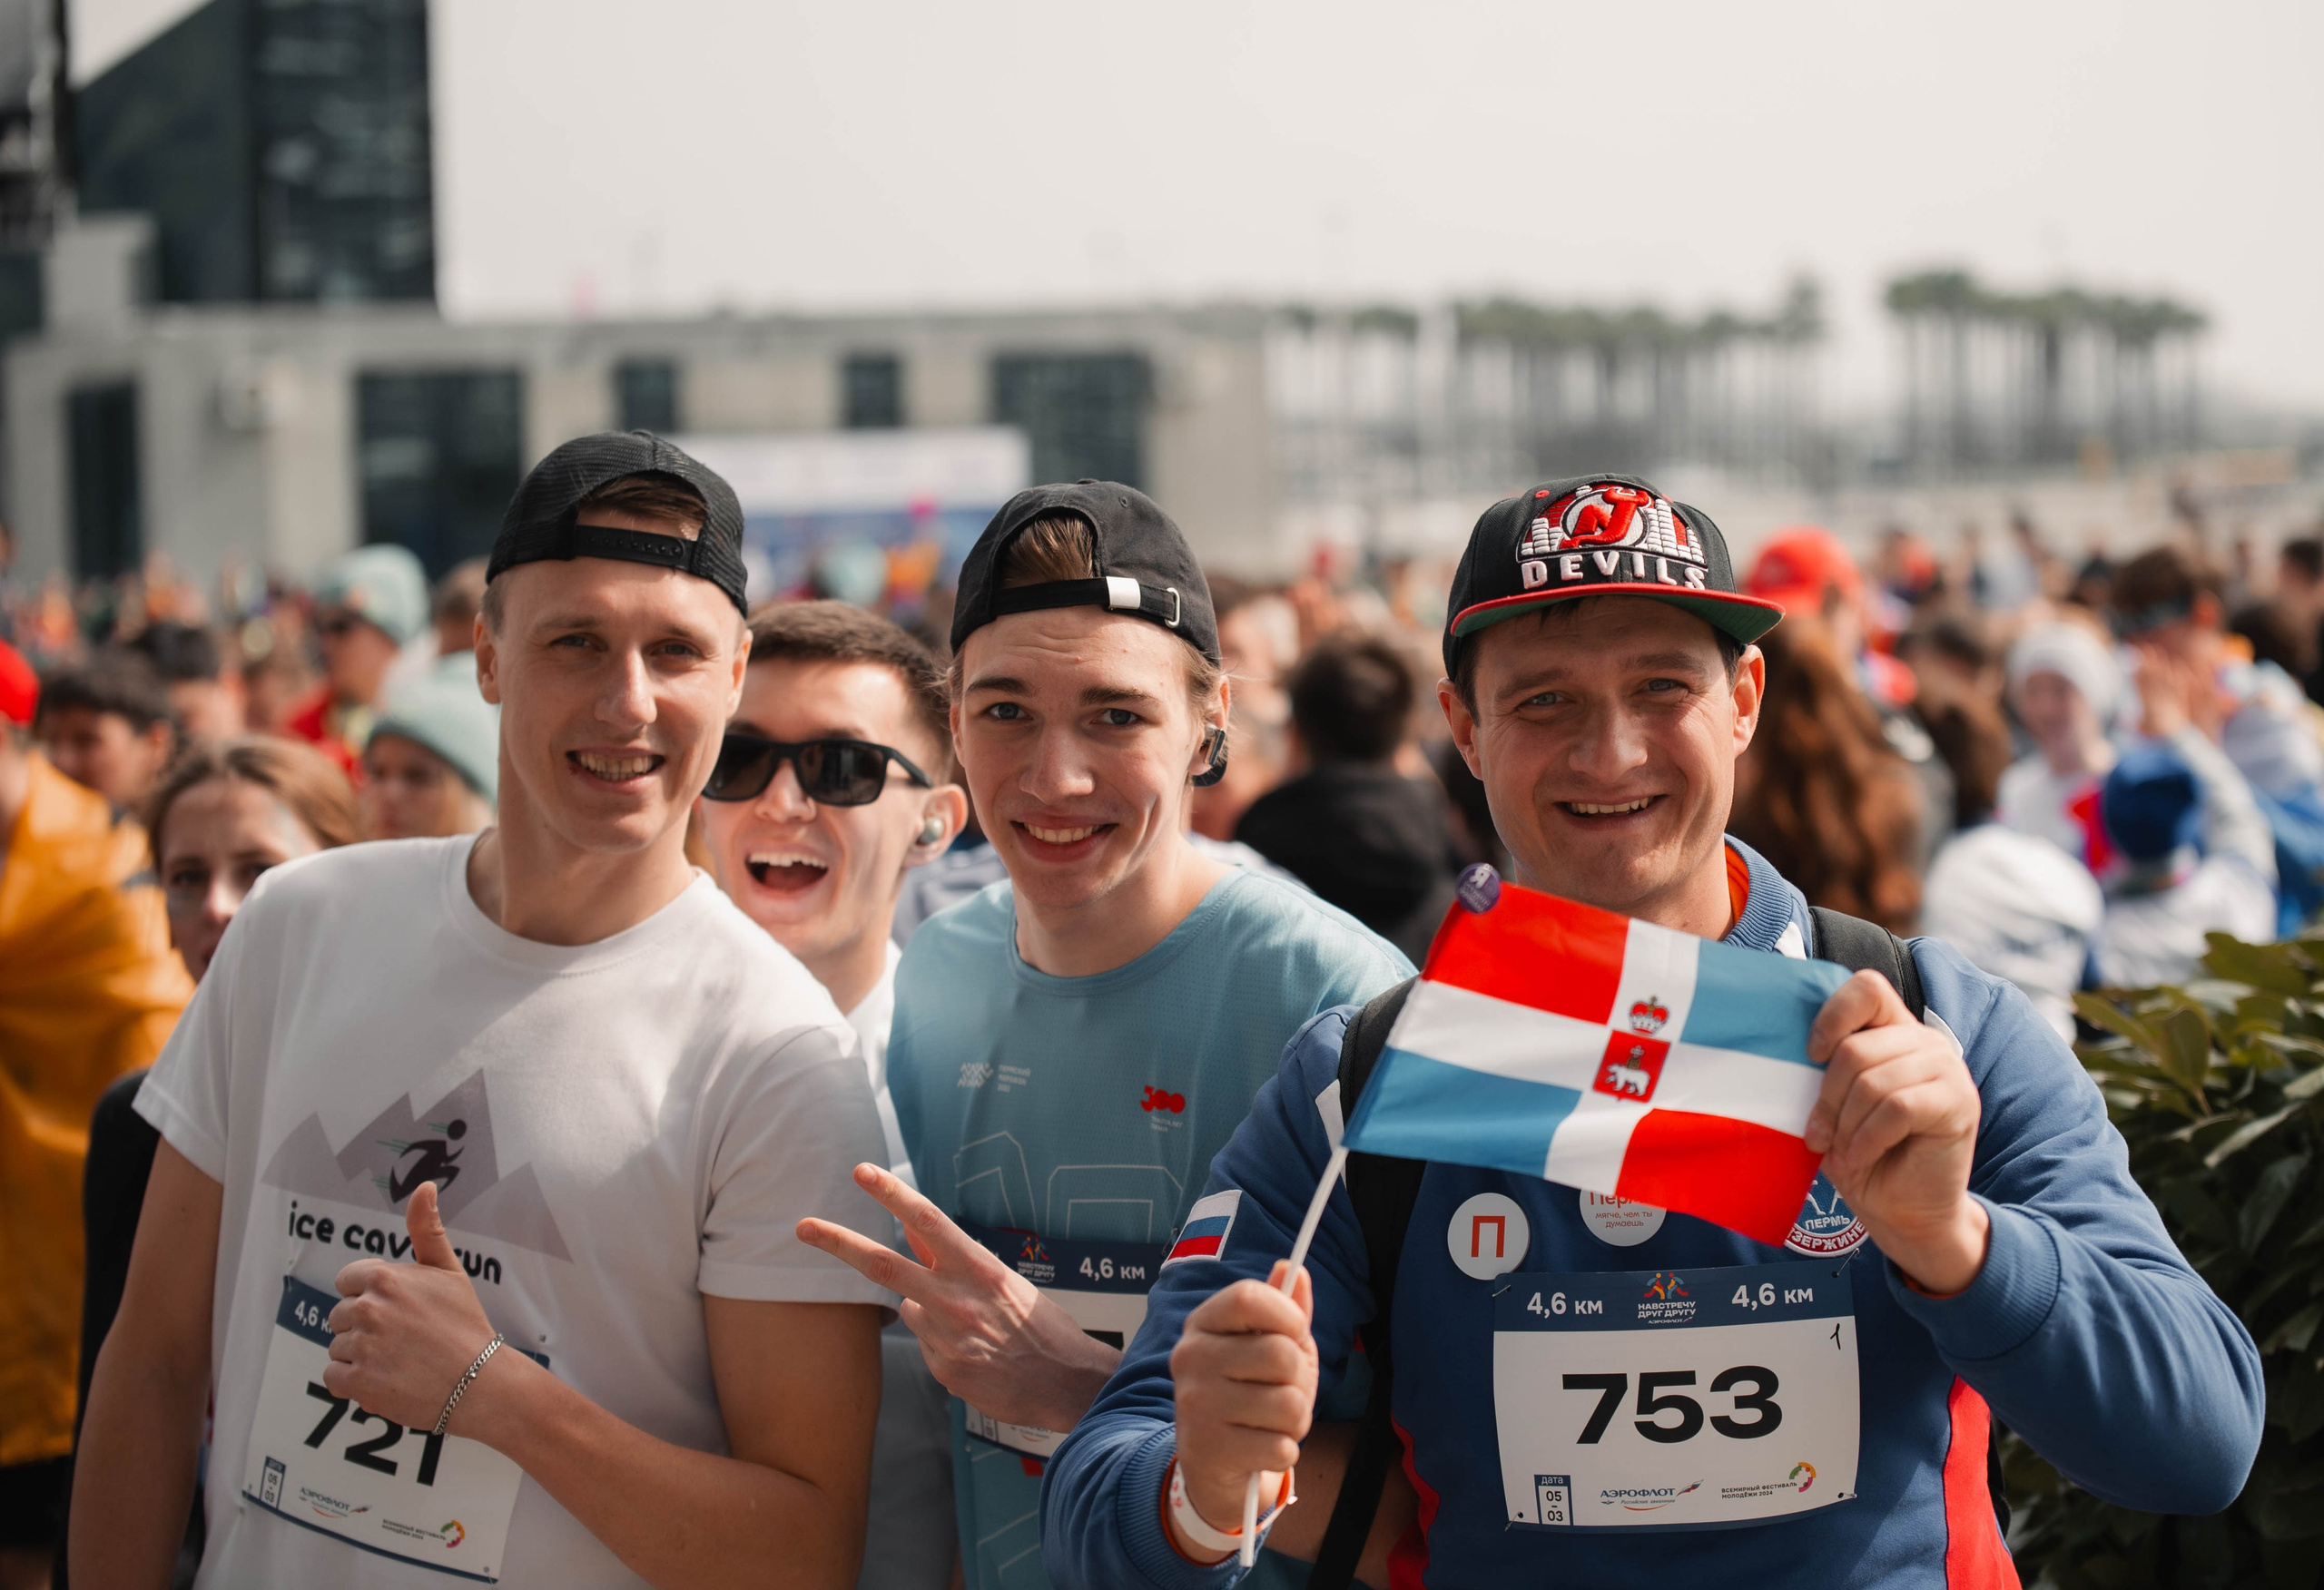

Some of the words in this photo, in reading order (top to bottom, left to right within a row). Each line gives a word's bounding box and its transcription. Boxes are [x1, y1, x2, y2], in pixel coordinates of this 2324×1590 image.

[1521, 550, 1706, 591] DEVILS
[288, 1200, 335, 1244] ice
[342, 1223, 418, 1261] cav
[1605, 1220, 1644, 1229] думаешь
[1805, 1215, 1851, 1231] ПЕРМЬ
[1471, 1215, 1506, 1259] П
[1079, 1257, 1115, 1281] 4,6
[1527, 1292, 1567, 1319] 4,6
[1575, 1300, 1603, 1315] км
[1638, 1300, 1696, 1310] НАВСТРЕЧУ
[1731, 1282, 1776, 1310] 4,6
[1784, 1287, 1814, 1304] км
[294, 1300, 319, 1328] 4,6
[320, 1317, 332, 1334] к
[1638, 1310, 1663, 1319] ДРУГ
[1664, 1309, 1697, 1318] ДРУГУ
[1561, 1365, 1783, 1445] 753
[303, 1380, 445, 1487] 721
[1541, 1476, 1563, 1485] дата
[1721, 1485, 1760, 1493] ВСЕМИРНЫЙ
[1761, 1482, 1797, 1490] ФЕСТИВАЛЬ
[300, 1487, 350, 1511] АЭРОФЛОТ
[1546, 1491, 1562, 1502] 05
[1600, 1488, 1676, 1497] АЭРОФЛОТ
[1721, 1491, 1758, 1499] МОЛОДЁЖИ
[1548, 1510, 1563, 1522] 03
